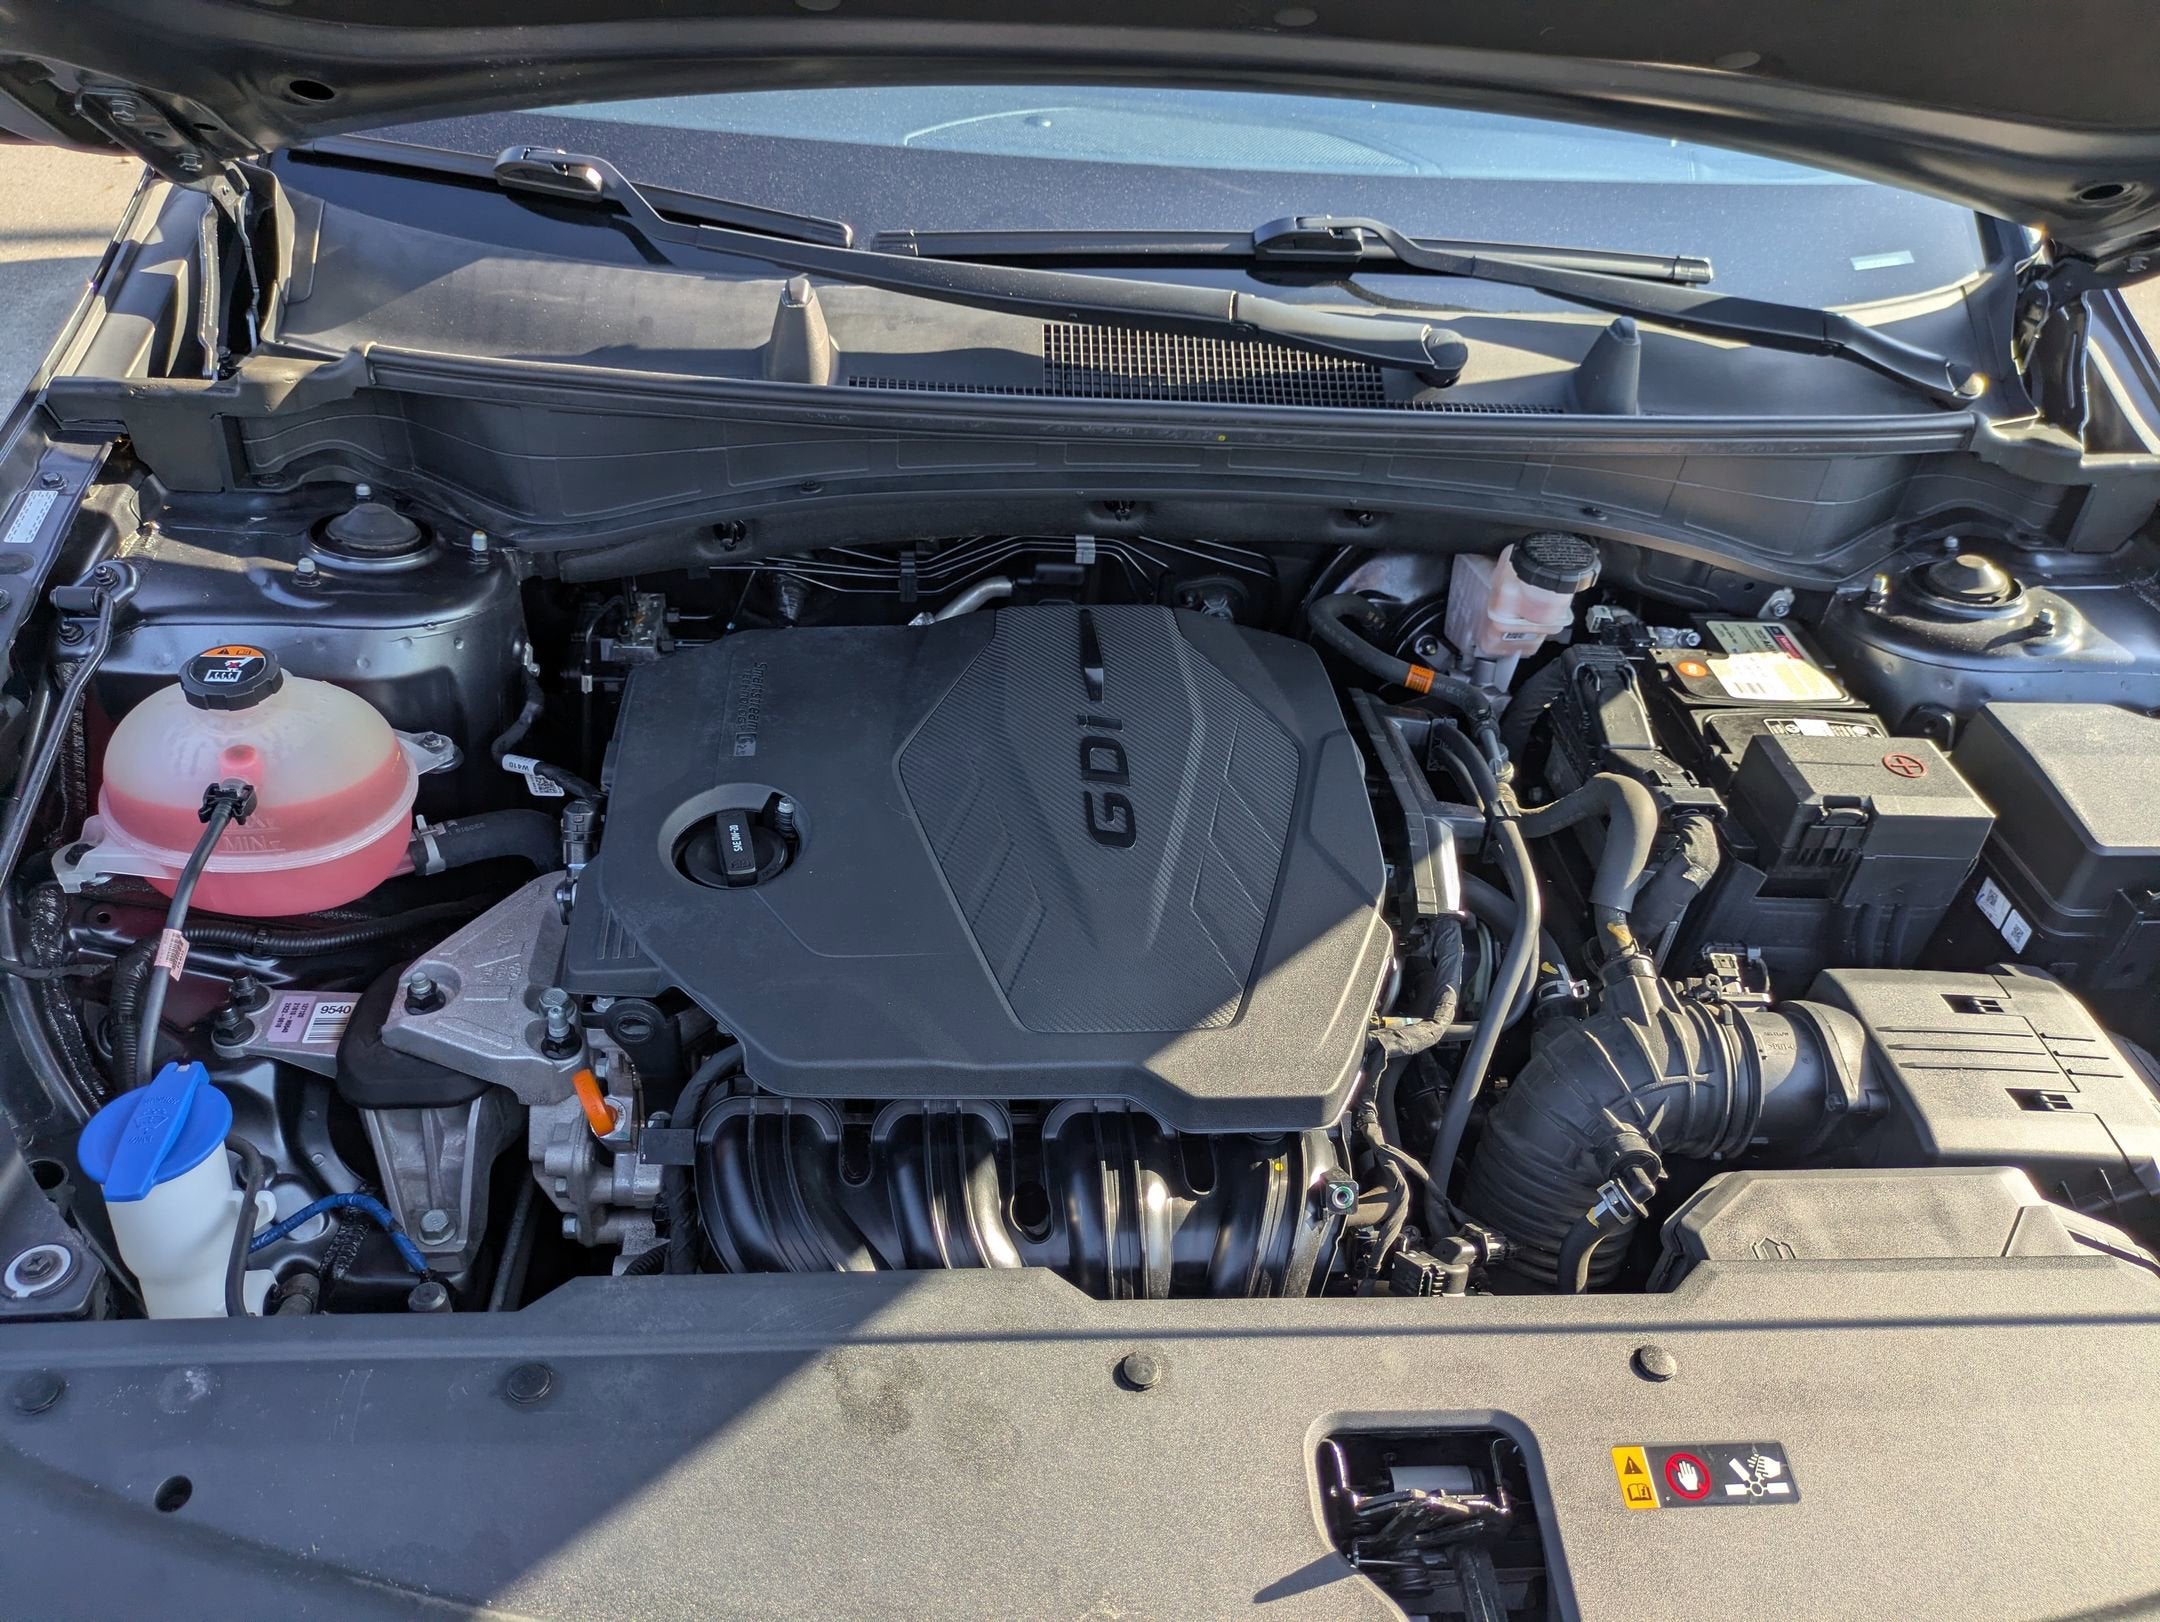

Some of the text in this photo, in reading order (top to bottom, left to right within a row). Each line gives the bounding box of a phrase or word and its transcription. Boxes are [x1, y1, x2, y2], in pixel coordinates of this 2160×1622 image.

[737, 669, 752, 730] TECHNOLOGY
[747, 662, 768, 731] Smartstream
[729, 824, 741, 841] 0W-20
[732, 840, 743, 852] SAE
[320, 1005, 352, 1014] 9540
